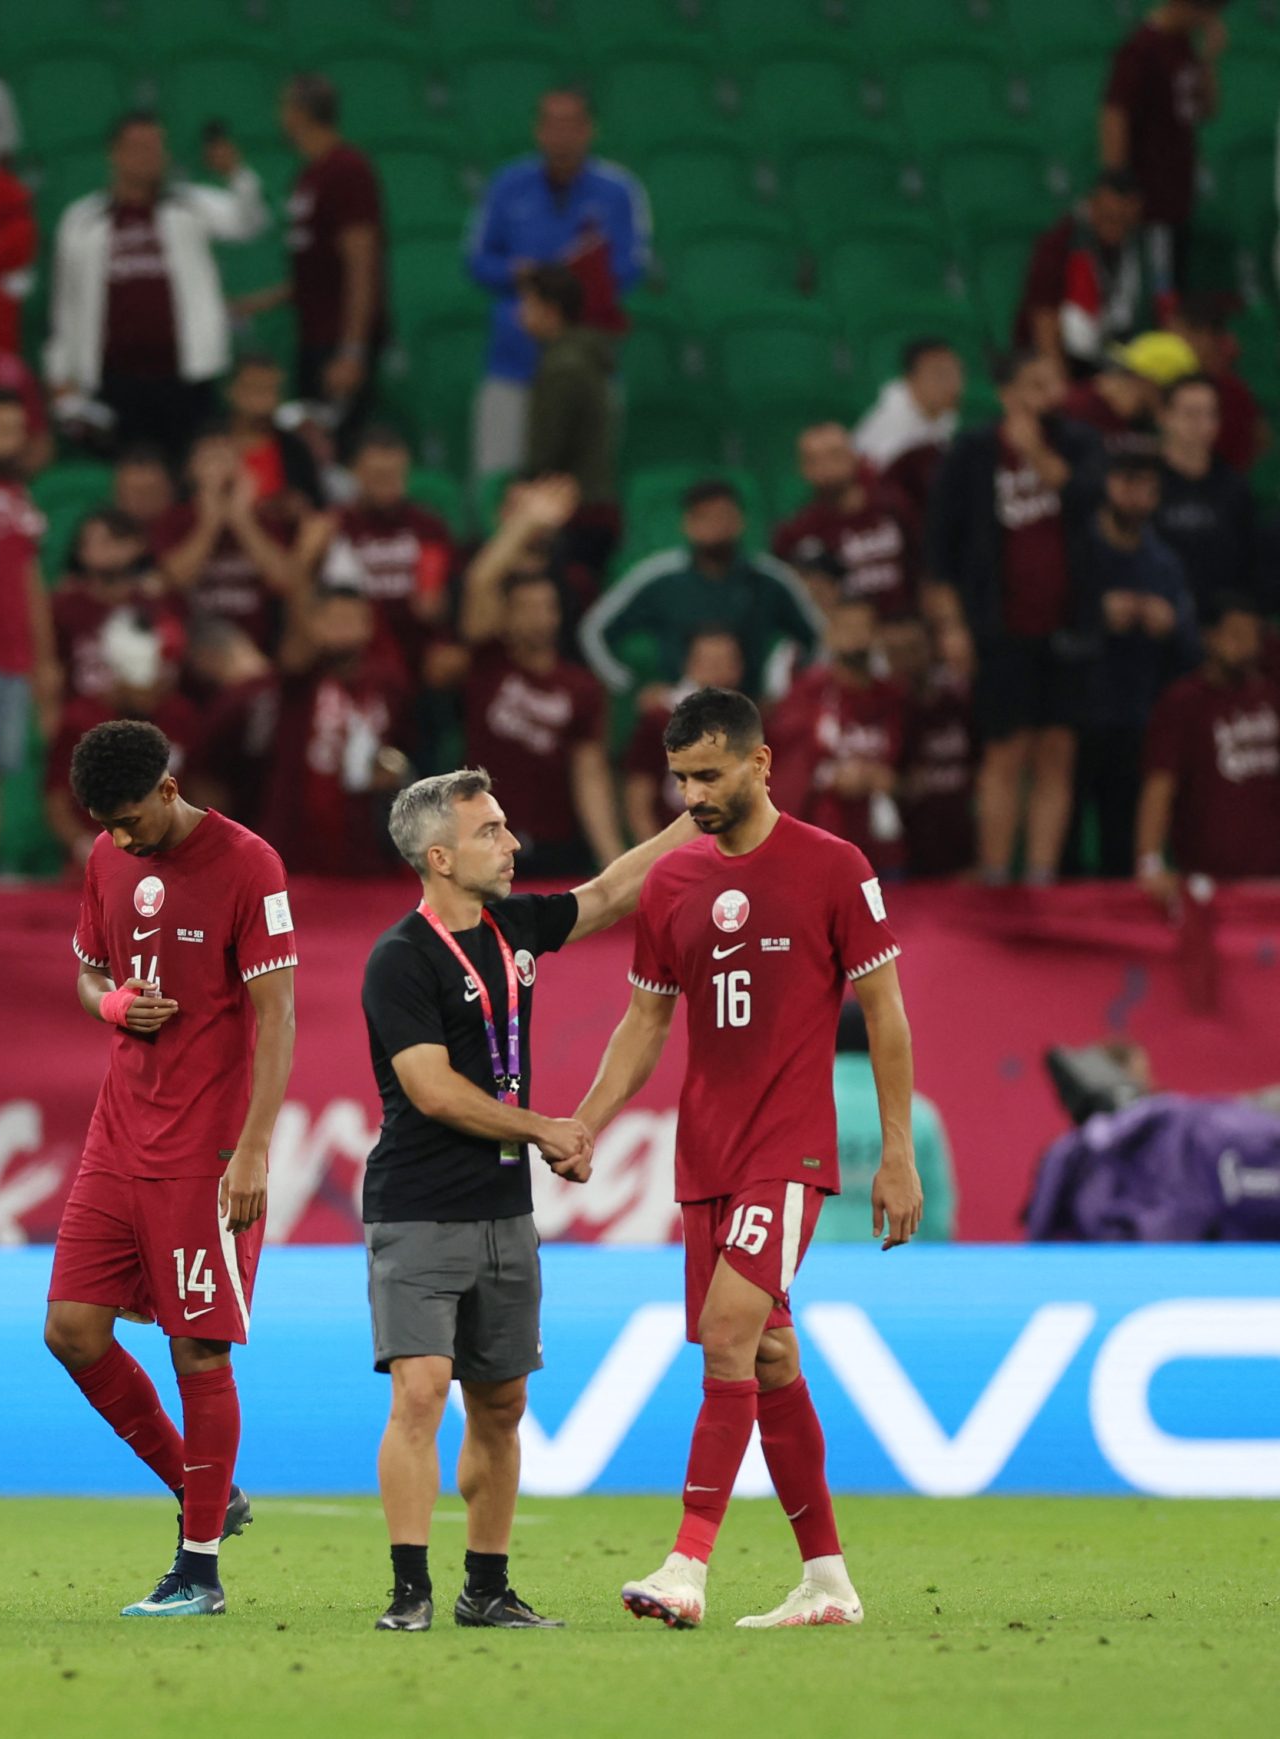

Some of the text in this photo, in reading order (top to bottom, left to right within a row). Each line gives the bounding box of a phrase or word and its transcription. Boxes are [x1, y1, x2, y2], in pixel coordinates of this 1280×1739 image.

[131, 954, 162, 999] 14
[712, 970, 751, 1028] 16
[726, 1203, 773, 1255] 16
[173, 1247, 216, 1303] 14
[448, 1297, 1280, 1499] vvo
